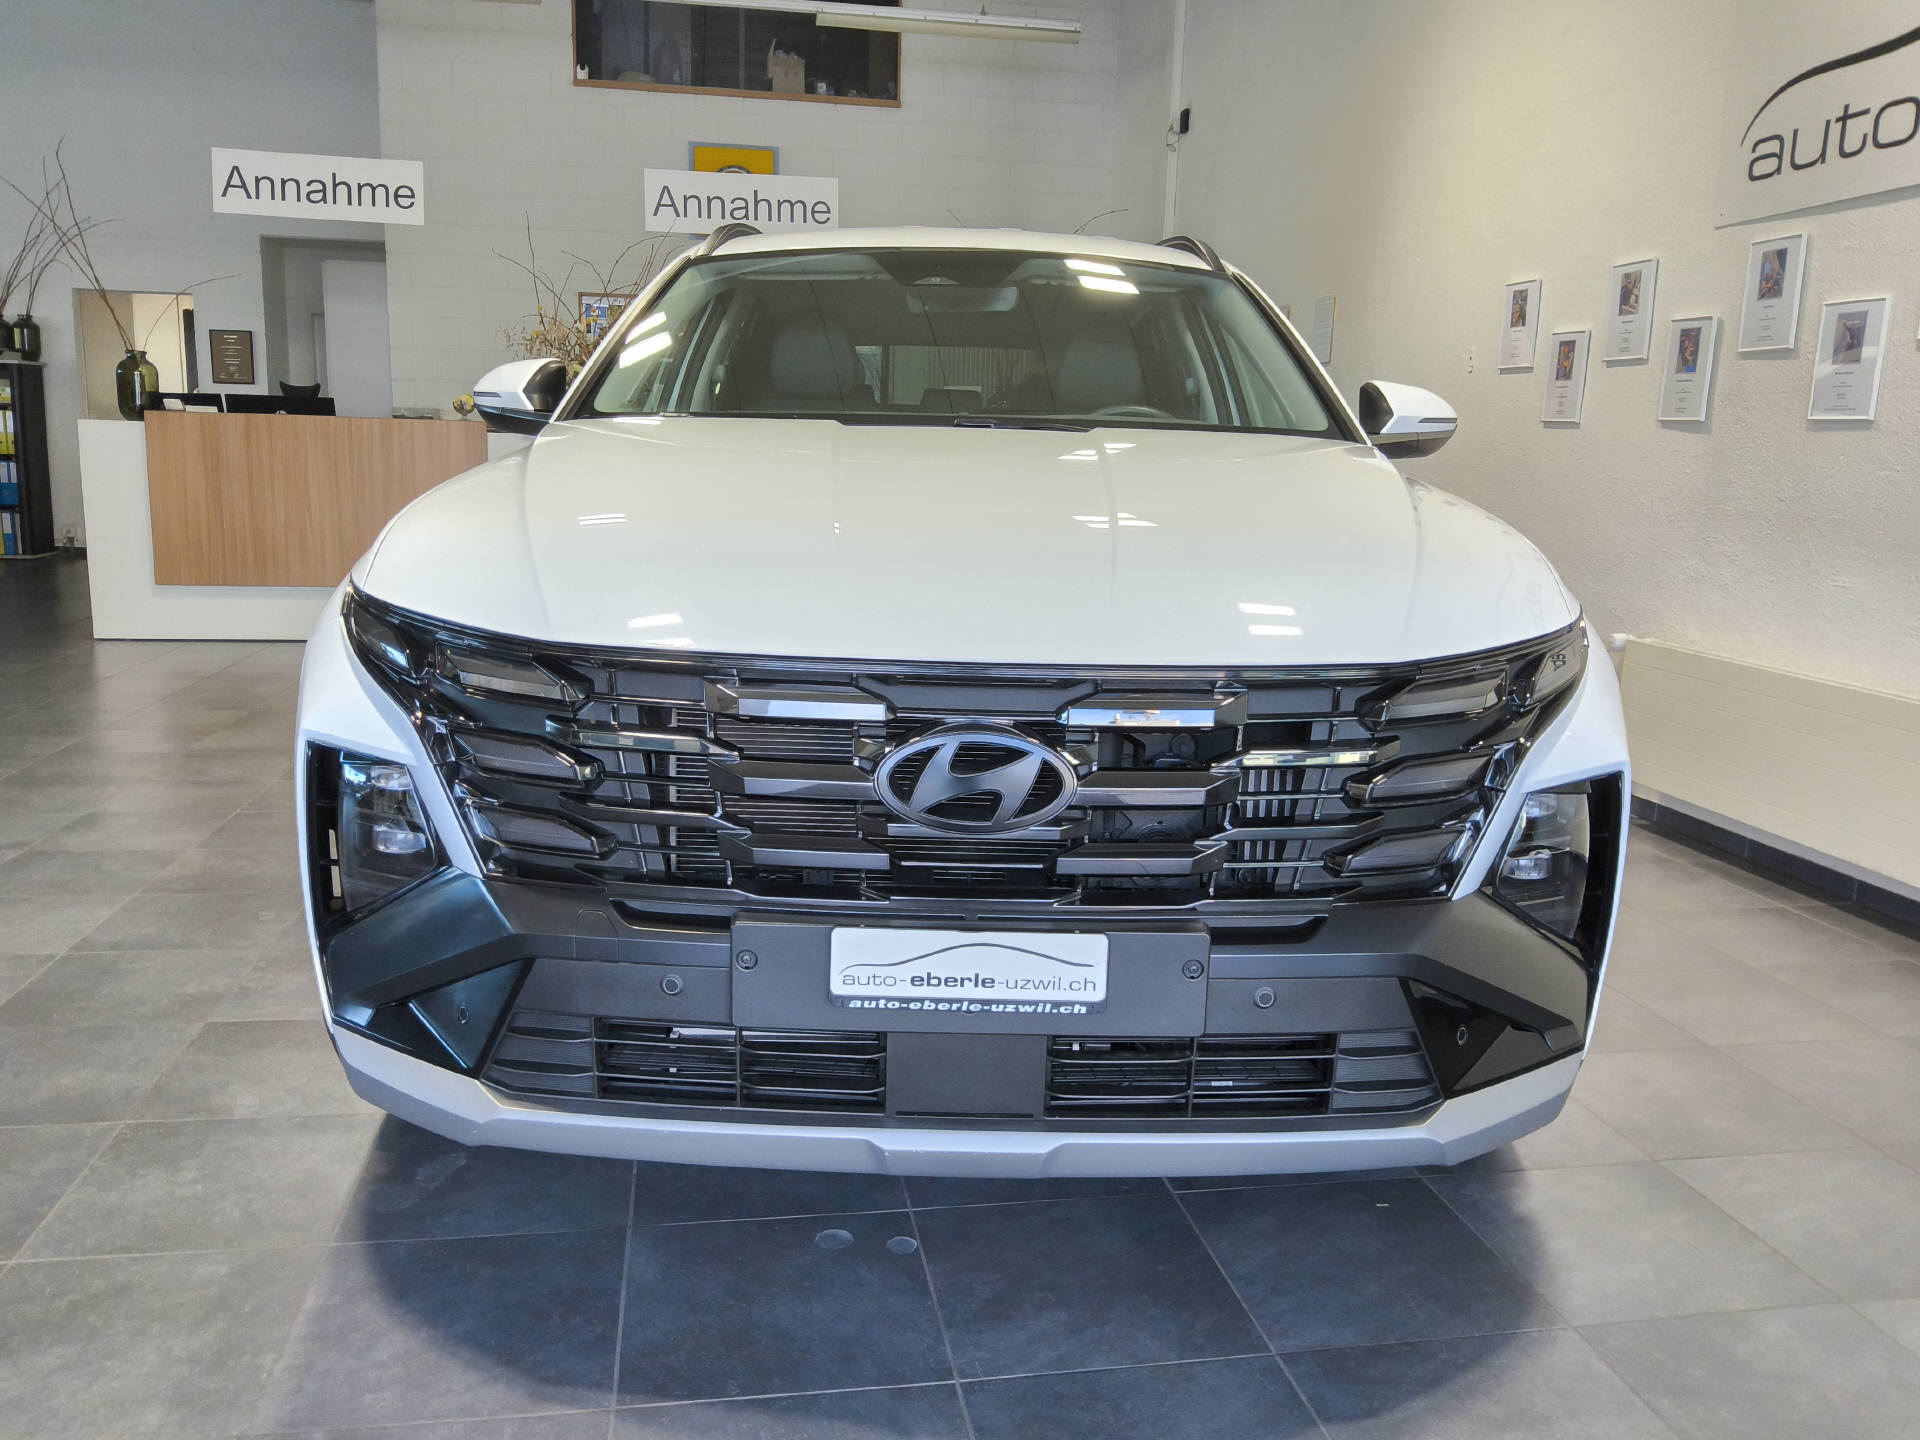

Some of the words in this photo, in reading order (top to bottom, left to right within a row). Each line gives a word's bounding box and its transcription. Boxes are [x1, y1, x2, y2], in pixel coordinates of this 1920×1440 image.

[221, 165, 416, 210] Annahme
[652, 184, 832, 225] Annahme
[842, 971, 1096, 992] auto-eberle-uzwil.ch
[848, 998, 1088, 1015] auto-eberle-uzwil.ch
